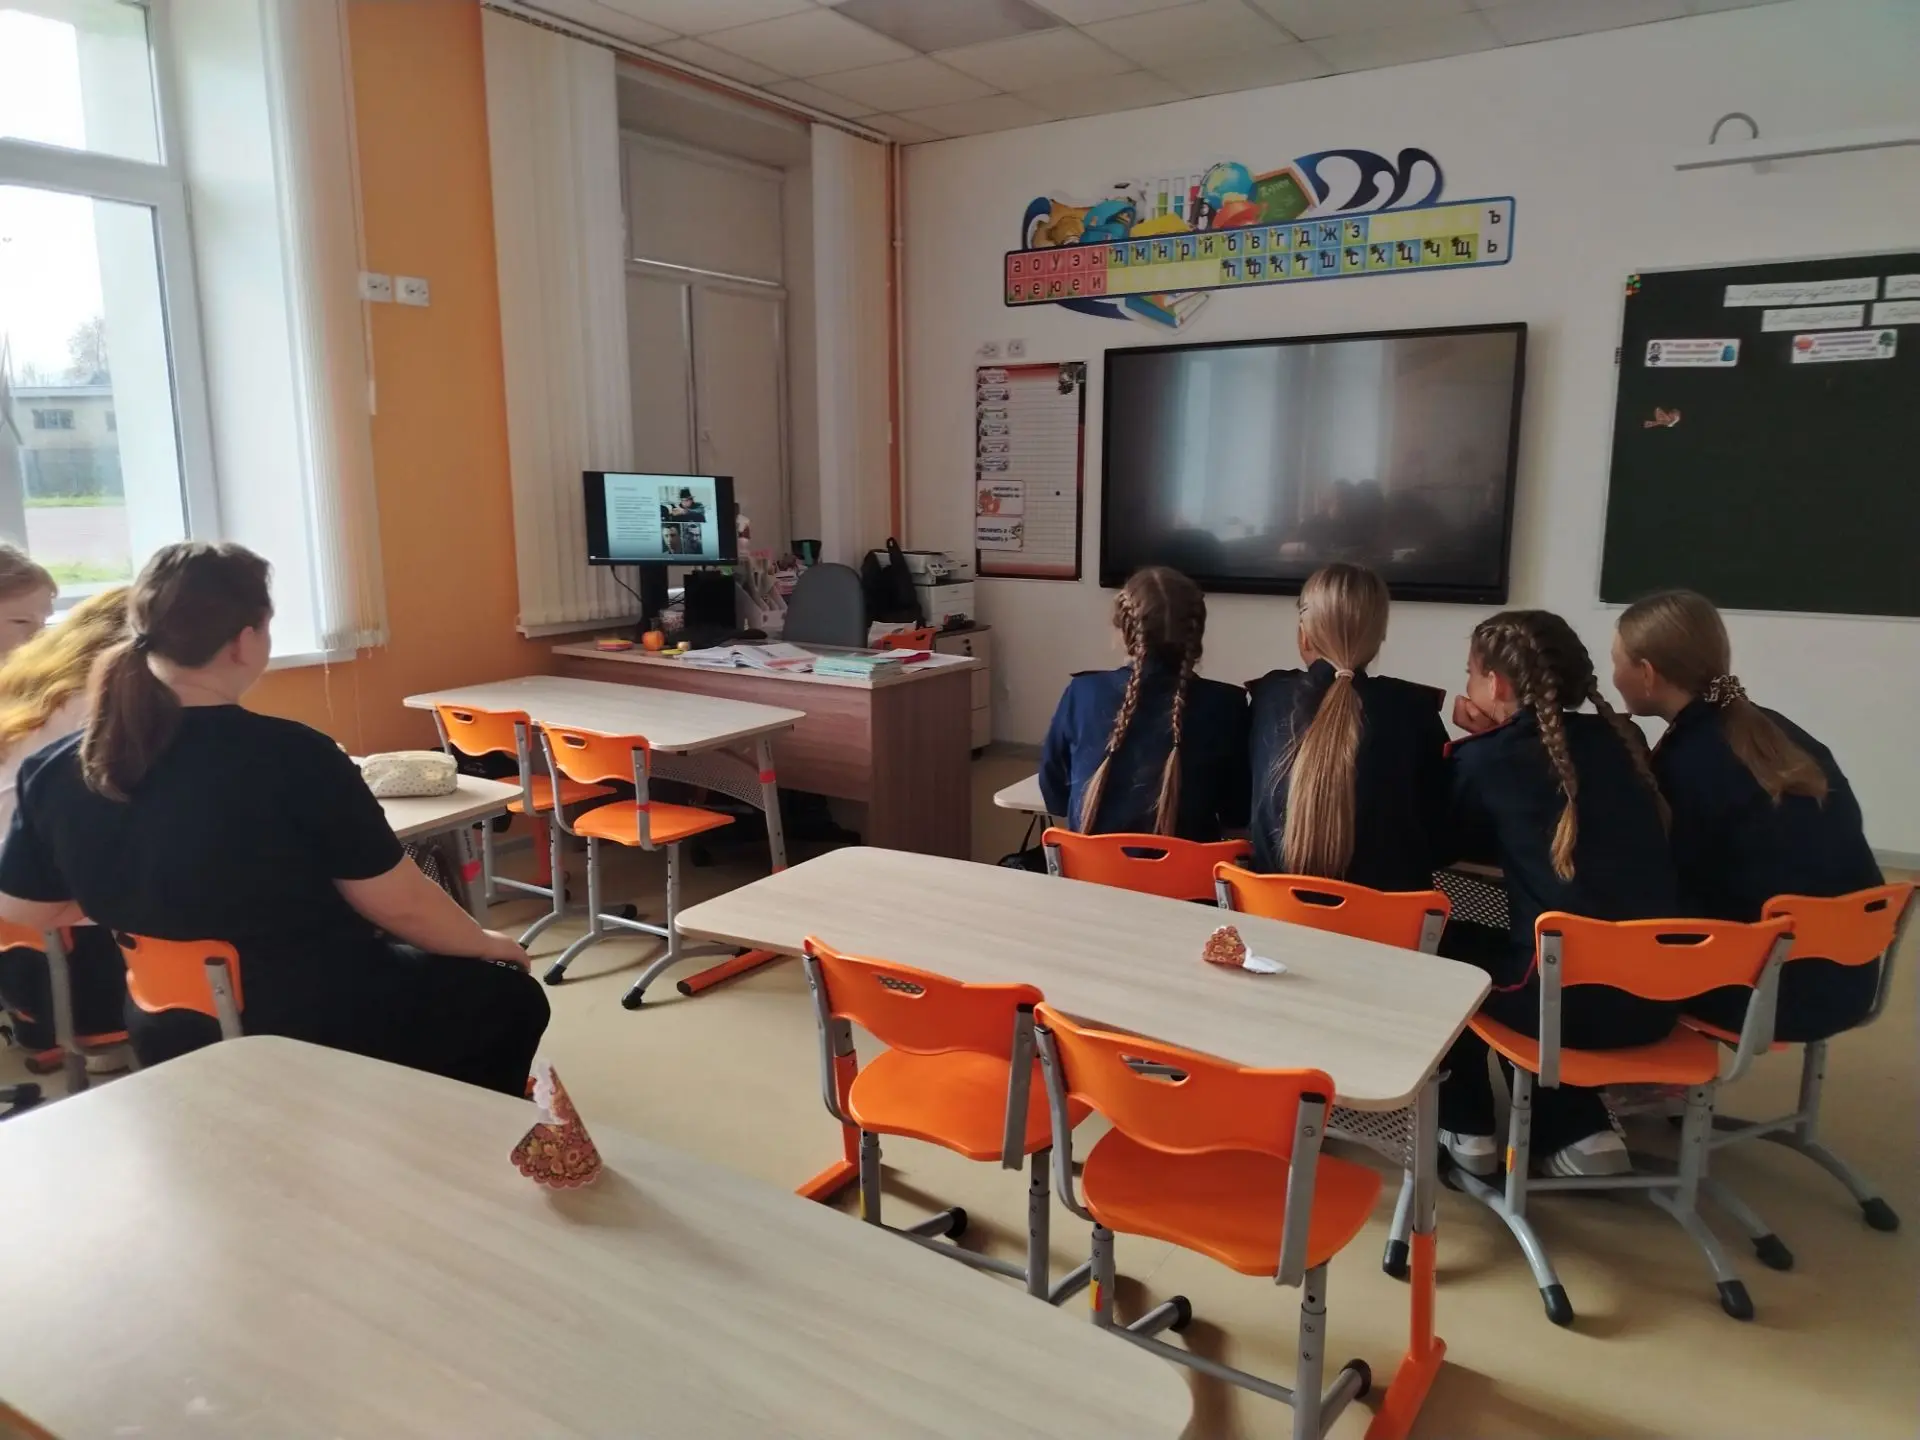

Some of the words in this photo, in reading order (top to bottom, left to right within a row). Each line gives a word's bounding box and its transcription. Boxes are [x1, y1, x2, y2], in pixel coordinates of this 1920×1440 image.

[1013, 260, 1021, 273] а
[1091, 251, 1103, 265] ы
[1227, 233, 1236, 251] б
